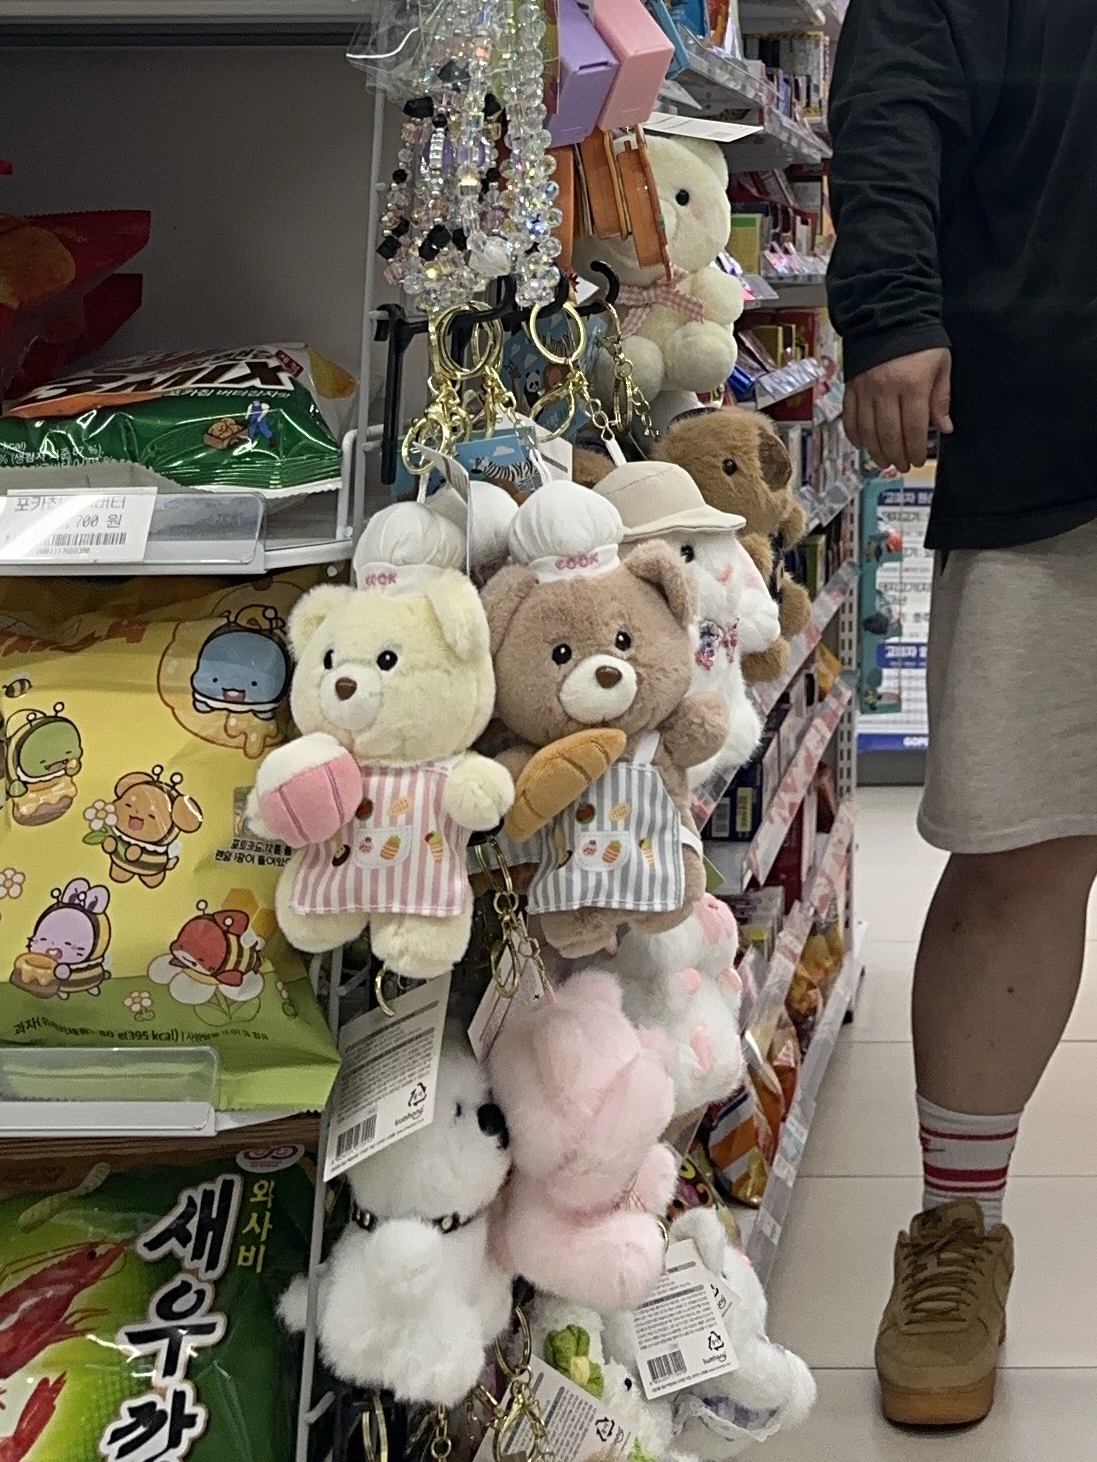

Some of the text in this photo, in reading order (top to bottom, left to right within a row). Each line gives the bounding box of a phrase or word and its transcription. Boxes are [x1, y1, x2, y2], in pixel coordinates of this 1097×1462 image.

[106, 513, 122, 529] 원
[555, 551, 599, 572] COOK
[237, 1179, 277, 1273] 와사비
